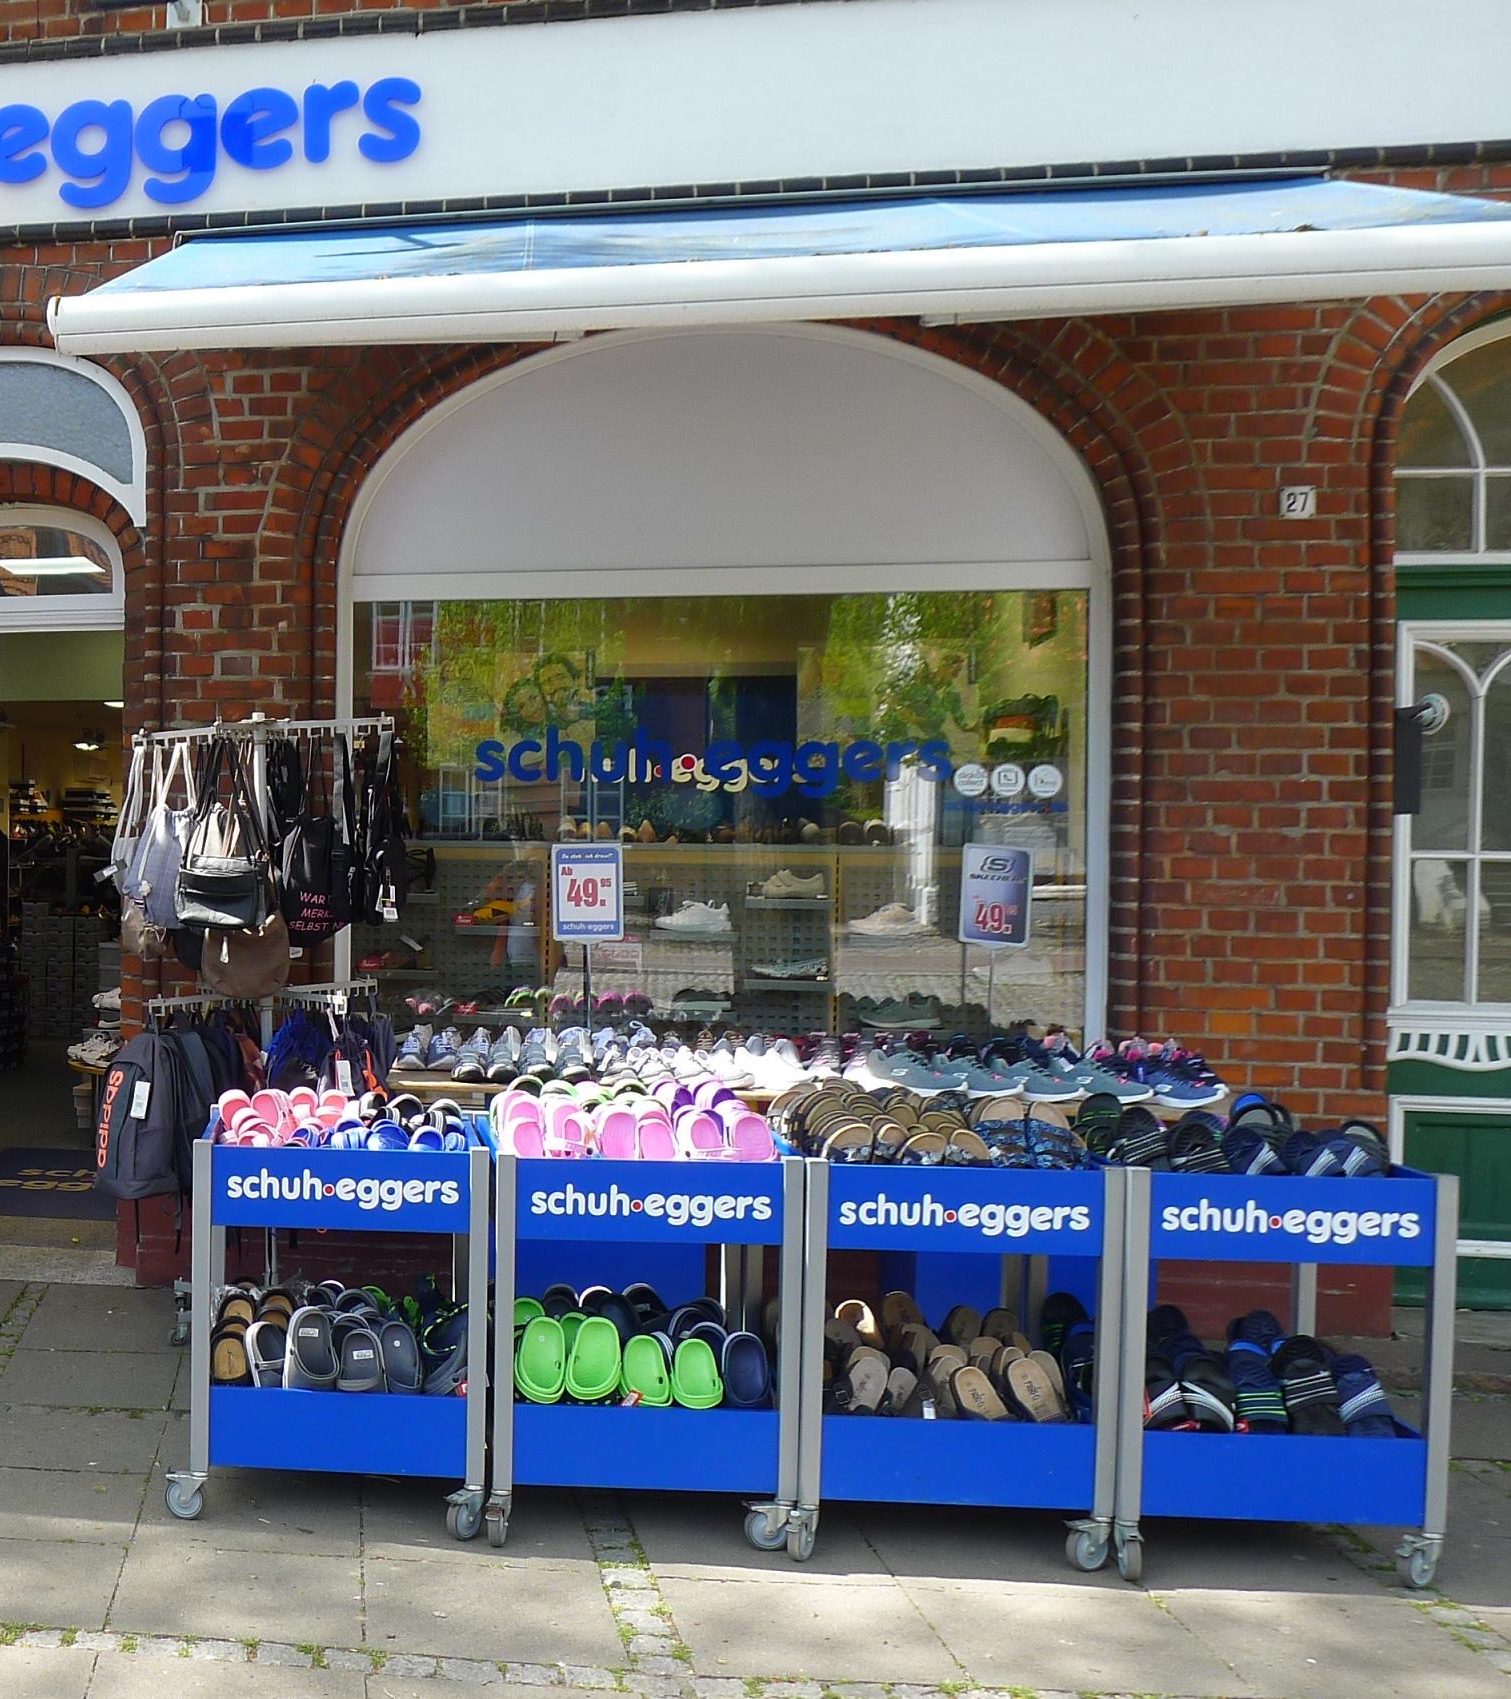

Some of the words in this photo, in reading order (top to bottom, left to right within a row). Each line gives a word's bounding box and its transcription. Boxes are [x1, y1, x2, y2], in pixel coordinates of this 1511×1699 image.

[1286, 491, 1309, 513] 27
[288, 920, 331, 932] SELBST
[96, 1070, 125, 1168] adidas
